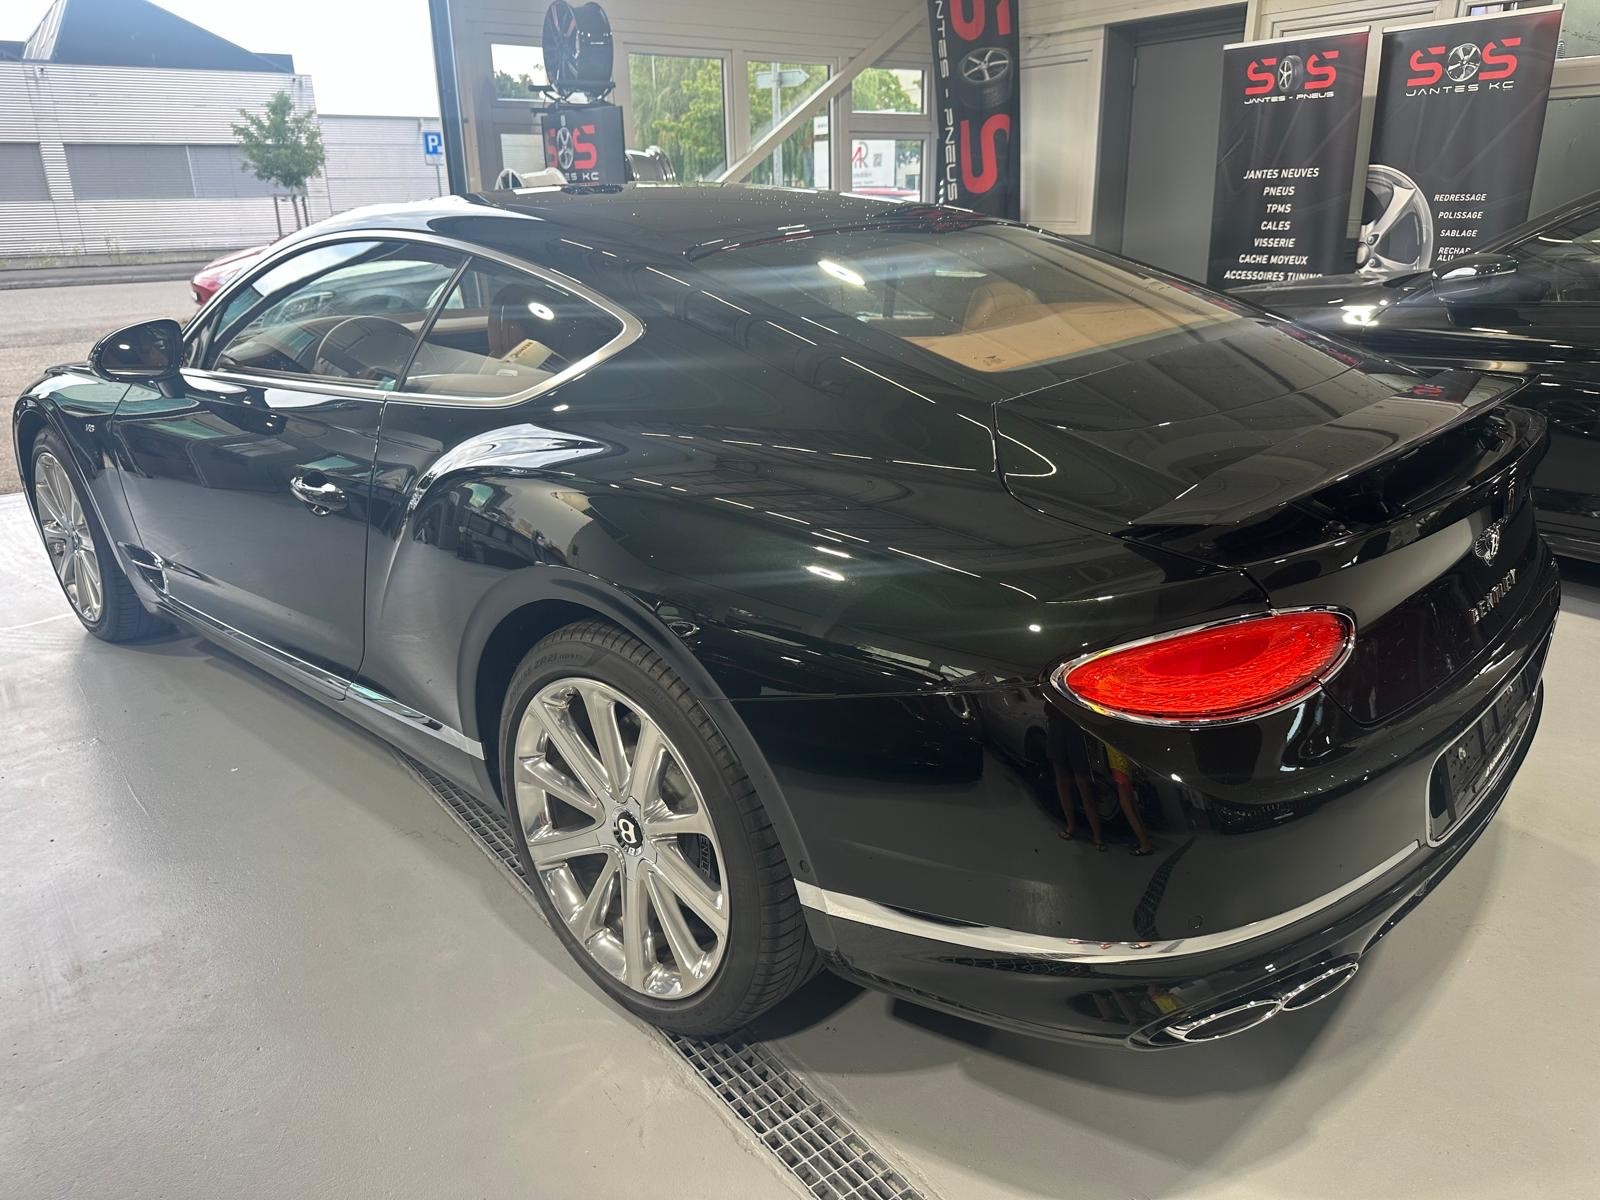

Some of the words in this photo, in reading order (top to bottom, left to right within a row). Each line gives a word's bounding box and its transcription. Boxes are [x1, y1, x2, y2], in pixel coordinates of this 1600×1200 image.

[1405, 84, 1479, 97] JANTES
[1489, 81, 1515, 90] KC
[936, 0, 950, 78] NTES
[944, 108, 958, 201] PNEUS
[1244, 95, 1286, 105] JANTES
[1296, 91, 1335, 100] PNEUS
[427, 135, 439, 153] P
[1243, 169, 1279, 179] JANTES
[1281, 168, 1320, 178] NEUVES
[1263, 186, 1295, 196] PNEUS
[1434, 193, 1487, 202] REDRESSAGE
[1266, 204, 1292, 213] TPMS
[1438, 211, 1484, 219] POLISSAGE
[1261, 221, 1291, 231] CALES
[1440, 229, 1478, 237] SABLAGE
[1254, 238, 1296, 248] VISSERIE
[1239, 254, 1269, 264] CACHE
[1269, 255, 1309, 265] MOYEUX
[1224, 270, 1285, 281] ACCESSOIRES
